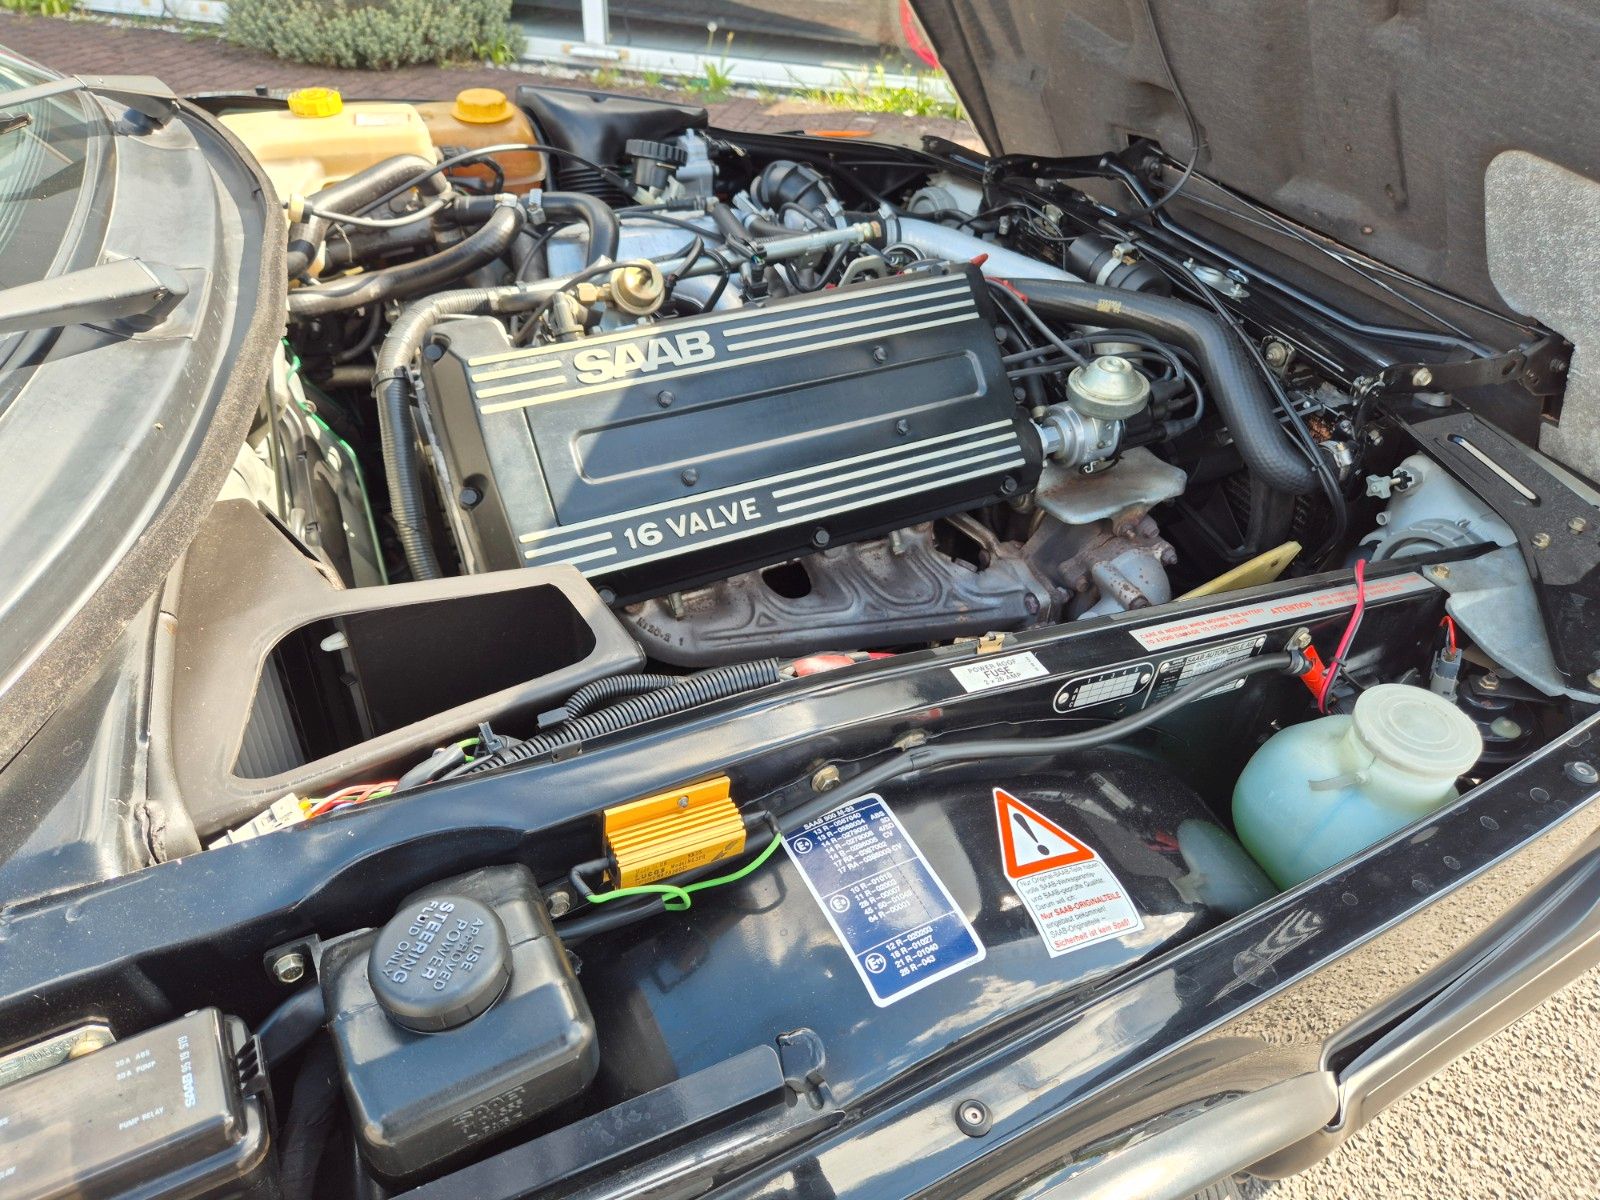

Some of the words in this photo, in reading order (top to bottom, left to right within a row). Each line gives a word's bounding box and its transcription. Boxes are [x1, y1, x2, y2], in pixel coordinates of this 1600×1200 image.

[573, 330, 716, 384] SAAB
[624, 522, 663, 549] 16
[665, 497, 761, 538] VALVE
[1270, 602, 1313, 614] ATTENTION
[1187, 654, 1205, 662] SAAB
[1205, 643, 1244, 658] AUTOMOBILE
[968, 662, 995, 673] POWER
[996, 658, 1016, 668] ROOF
[984, 666, 1013, 679] FUSE
[1005, 672, 1021, 680] AMP
[803, 818, 823, 830] SAAB
[824, 813, 837, 821] 900
[817, 834, 826, 842] 13
[870, 810, 885, 820] ABS
[821, 840, 830, 848] 14
[825, 846, 835, 854] 14
[829, 853, 839, 861] 14
[882, 830, 893, 839] CV
[837, 866, 847, 875] 17
[850, 886, 860, 894] 10
[855, 893, 864, 901] 11
[1035, 901, 1055, 911] Darum
[408, 901, 439, 936] FLUID
[1041, 912, 1054, 920] Nur
[1046, 916, 1074, 929] eingebaut
[392, 902, 455, 984] STEERING
[1054, 932, 1088, 948] Sicherheit
[1089, 929, 1098, 937] ist
[1098, 926, 1112, 934] kein
[421, 919, 468, 980] POWER
[433, 917, 485, 991] APPROVED
[885, 942, 897, 951] 12
[382, 941, 410, 977] ONLY
[460, 944, 485, 972] USE
[894, 959, 905, 968] 21
[135, 1049, 150, 1060] ABS
[136, 1060, 157, 1073] PUMP
[182, 1072, 196, 1109] SAAB
[118, 1116, 140, 1130] PUMP
[141, 1106, 164, 1121] RELAY
